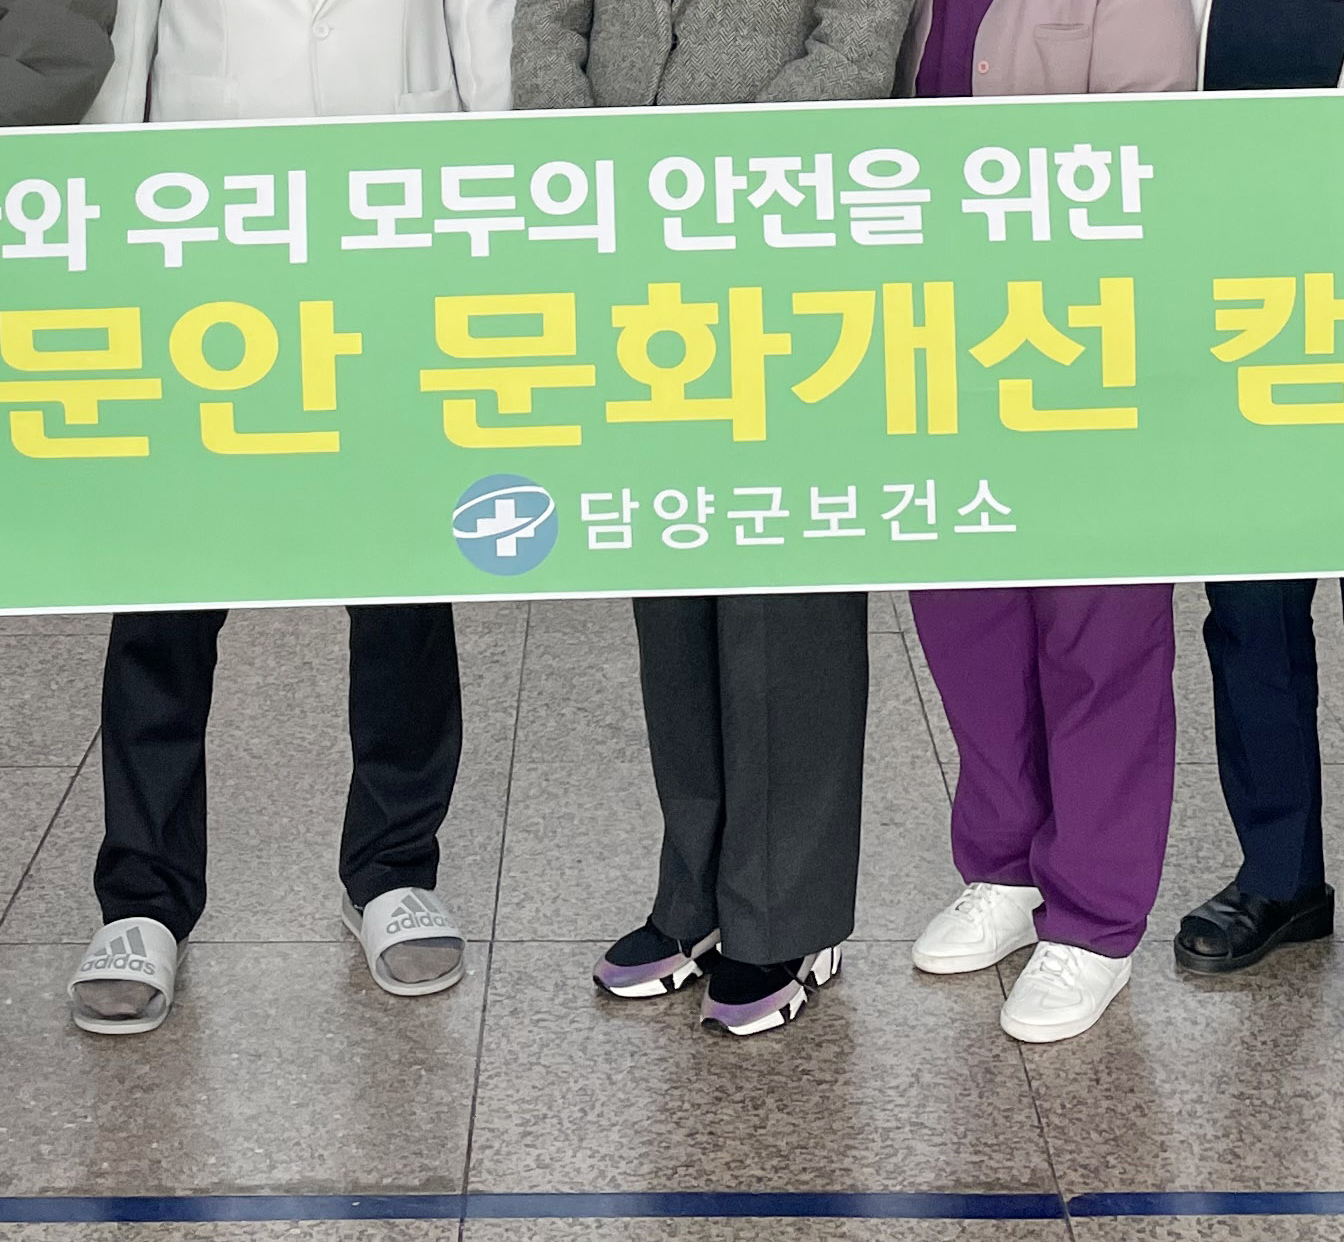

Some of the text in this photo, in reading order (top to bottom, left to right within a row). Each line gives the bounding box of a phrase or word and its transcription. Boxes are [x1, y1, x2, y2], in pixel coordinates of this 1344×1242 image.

[127, 169, 308, 268] 우리
[340, 159, 617, 258] 모두의
[648, 149, 932, 252] 안전을
[961, 143, 1154, 242] 위한
[419, 277, 1138, 448] 문화개선
[580, 477, 1018, 551] 담양군보건소
[385, 910, 455, 935] adidas
[80, 952, 156, 976] adidas
